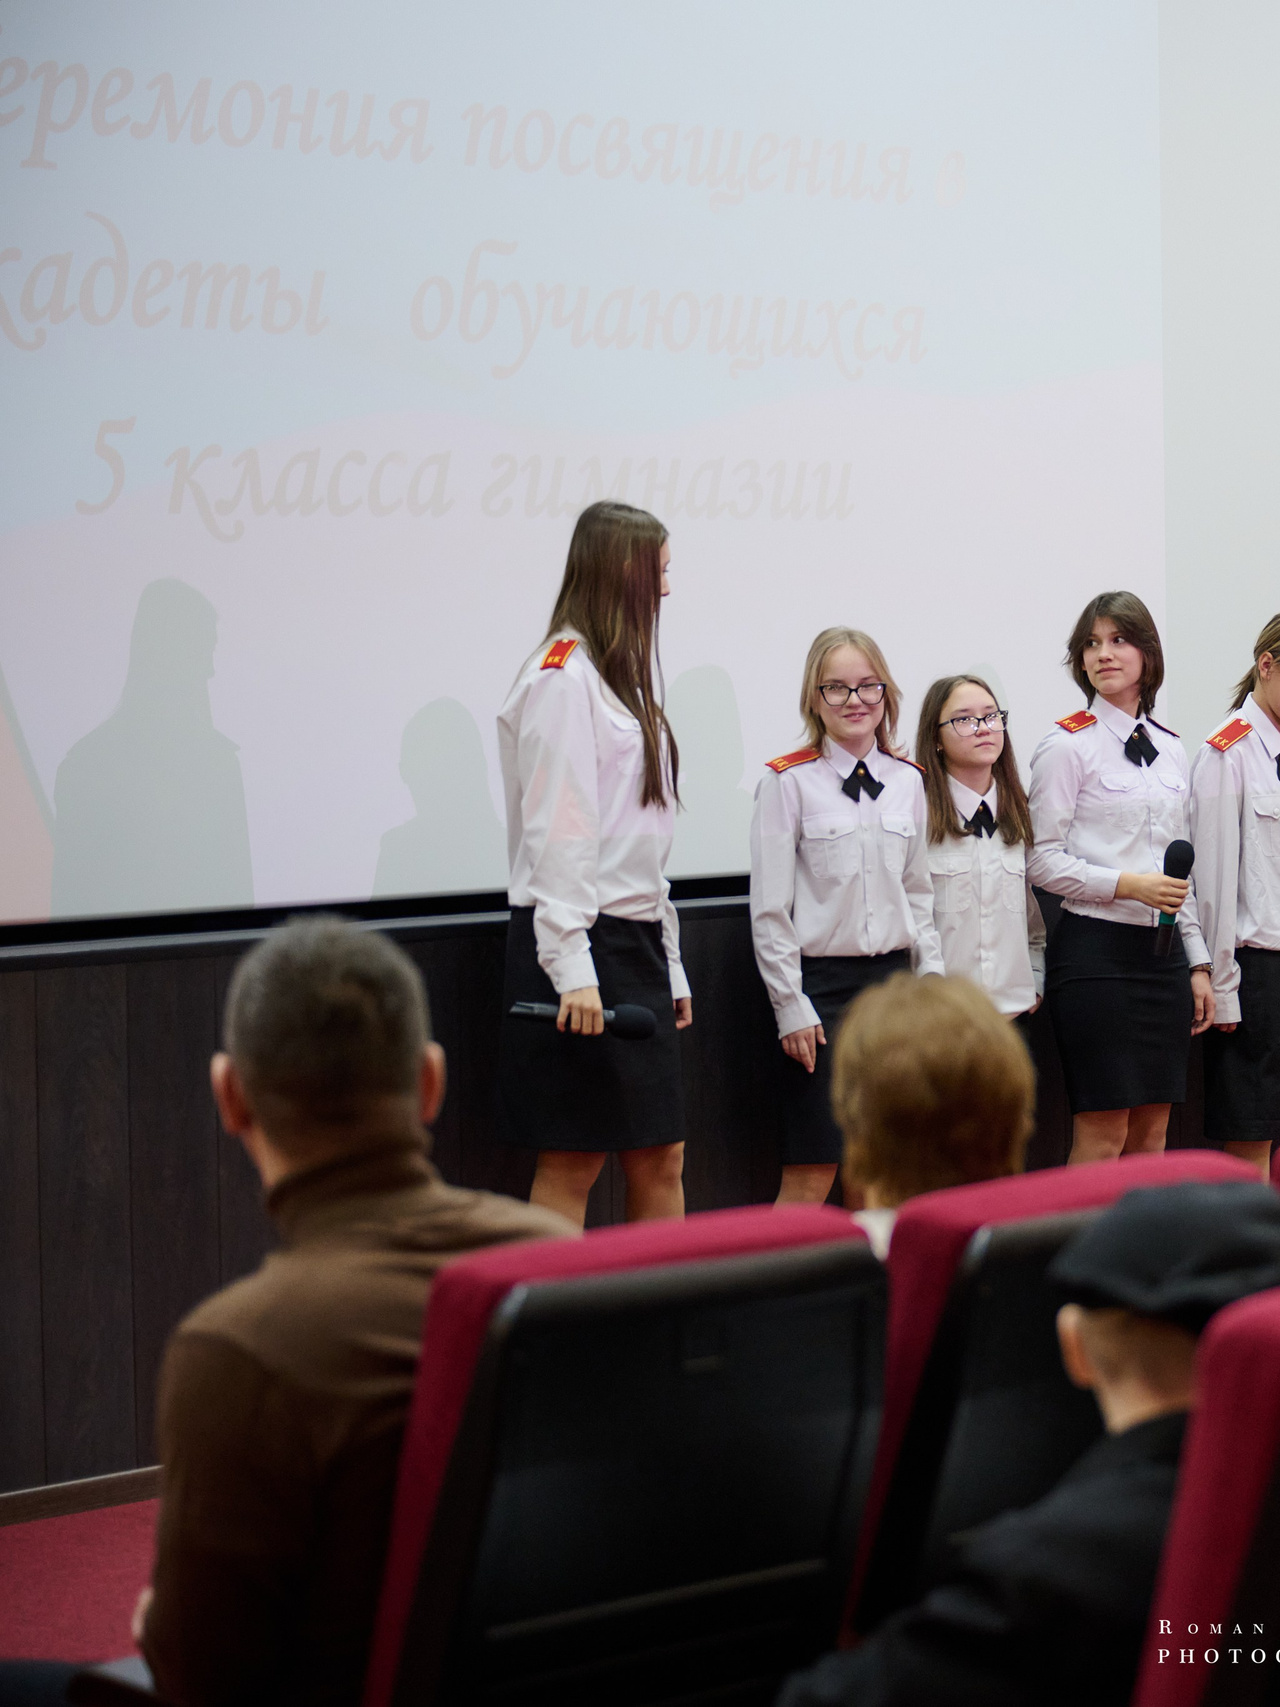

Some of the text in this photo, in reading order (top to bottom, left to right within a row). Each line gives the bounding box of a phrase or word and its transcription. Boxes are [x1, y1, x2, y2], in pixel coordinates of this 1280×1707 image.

[0, 57, 967, 213] еремония посвящения в
[409, 239, 929, 381] обучающихся
[75, 416, 856, 543] 5 класса гимназии
